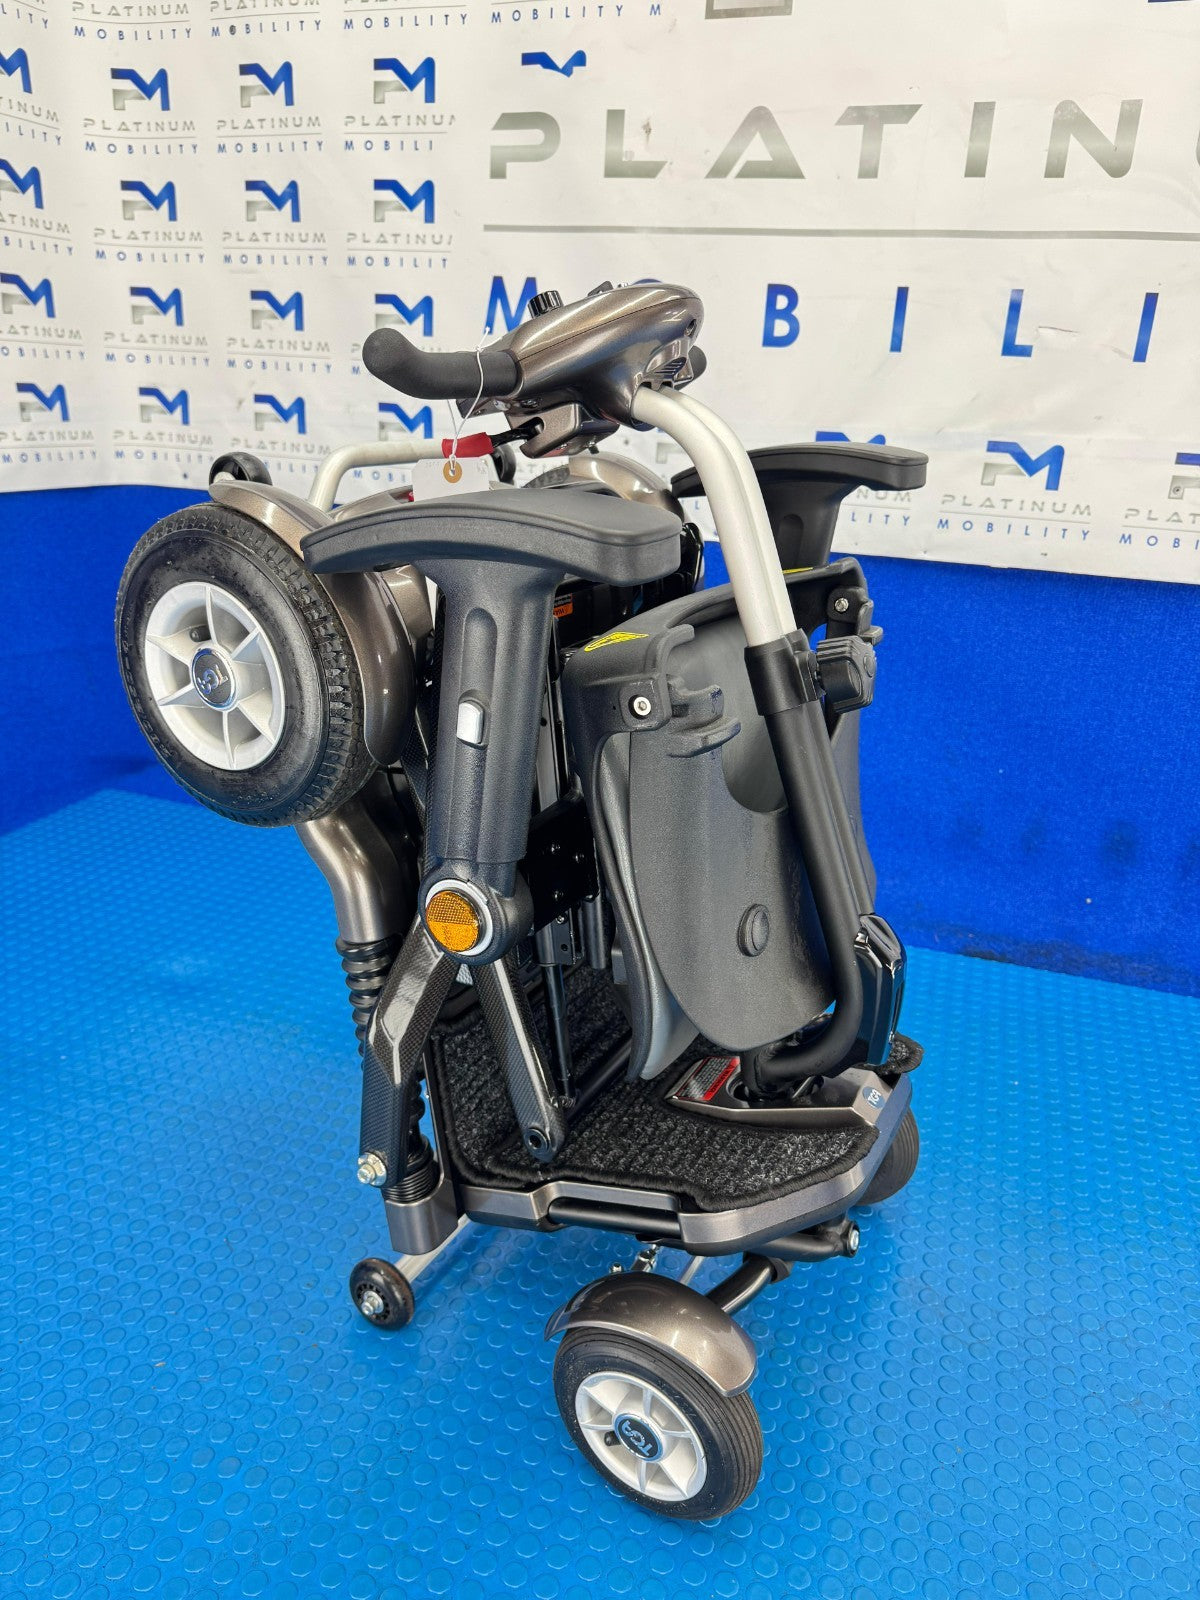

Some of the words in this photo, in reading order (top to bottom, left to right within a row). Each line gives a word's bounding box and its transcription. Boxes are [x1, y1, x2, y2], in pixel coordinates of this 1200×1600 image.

[72, 1, 189, 17] PLATINUM
[491, 5, 623, 23] MOBILITY
[344, 13, 467, 29] MOBILITY
[74, 26, 191, 41] MOBILITY
[83, 117, 196, 132] PLATINUM
[216, 116, 321, 131] PLATINUM
[217, 140, 324, 154] MOBILITY
[489, 99, 1200, 180] PLATIN
[85, 140, 197, 155] MOBILITY
[93, 227, 204, 242] PLATINUM
[222, 231, 327, 244] PLATINUM
[346, 232, 452, 246] PLATINU
[95, 249, 205, 263] MOBILITY
[223, 254, 328, 267] MOBILITY
[485, 275, 1159, 362] MBILI
[0, 324, 83, 340] ATINUM
[104, 331, 208, 347] PLATINUM
[226, 337, 331, 352] PLATINUM
[105, 352, 210, 367] MOBILITY
[227, 358, 332, 374] MOBILITY
[941, 494, 1093, 517] PLATINUM
[936, 518, 1091, 541] MOBILITY
